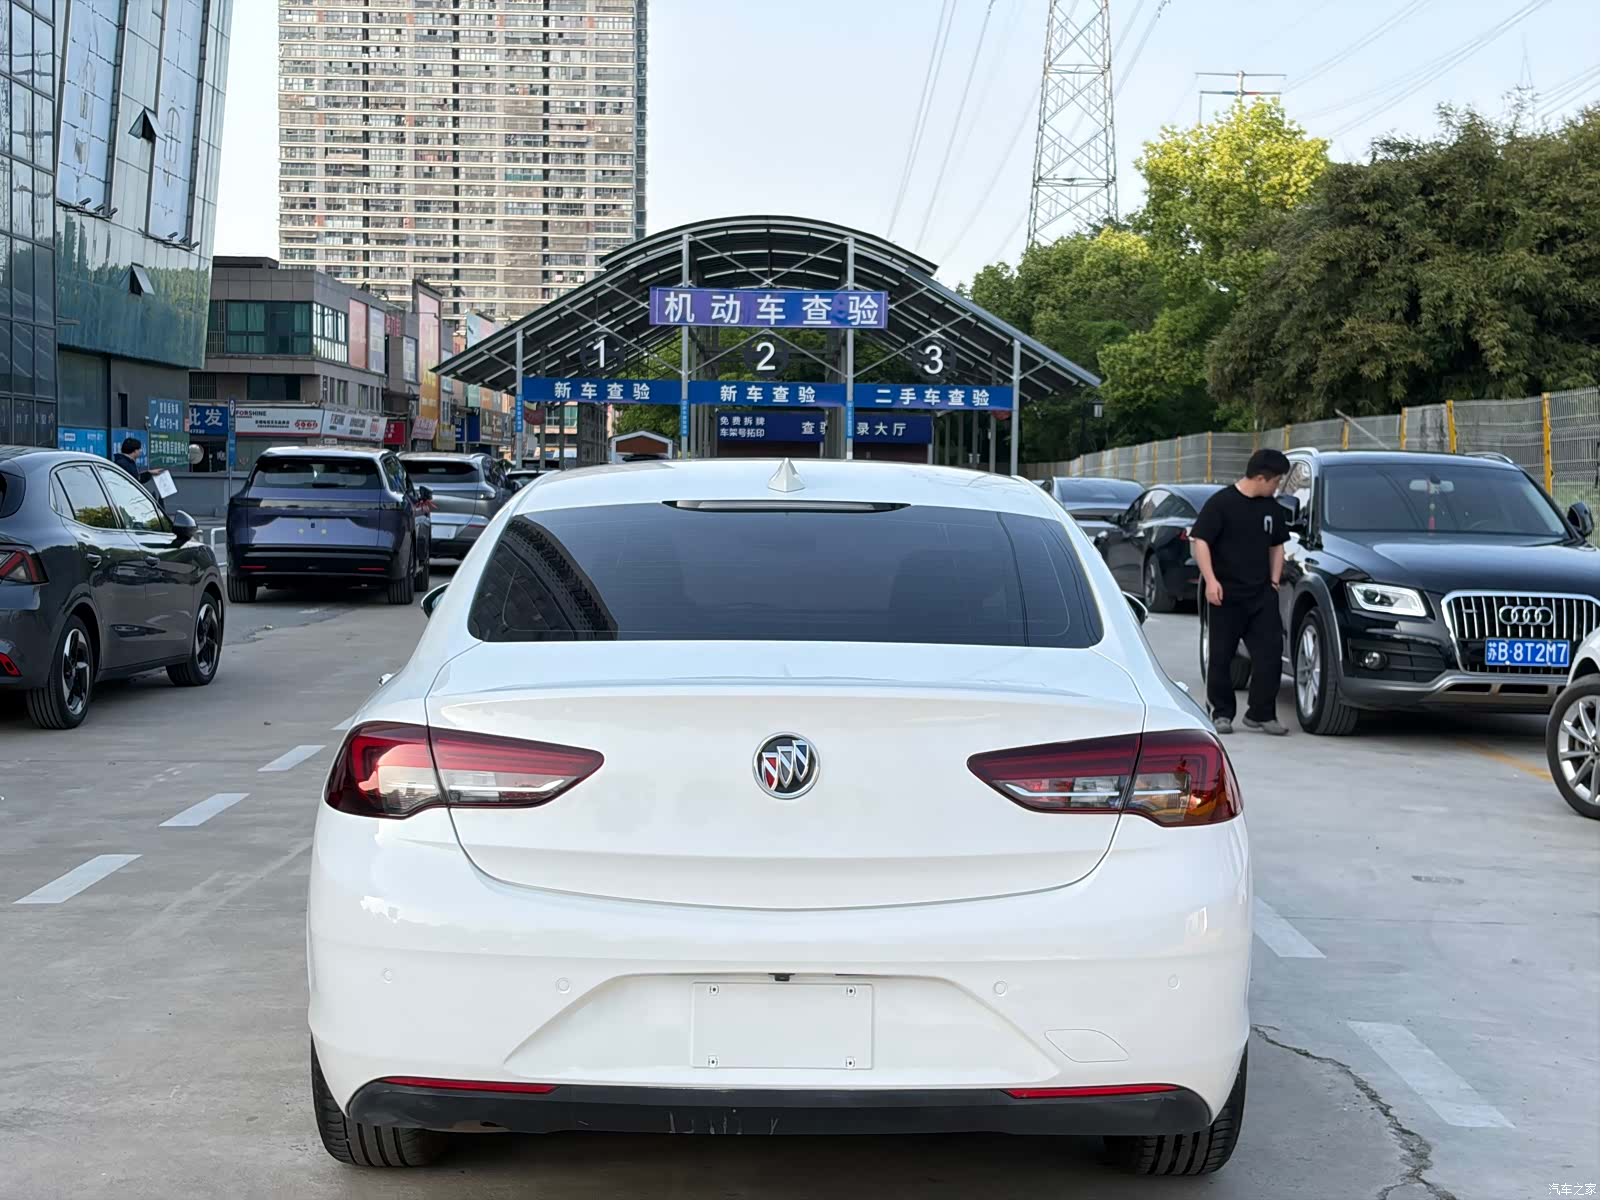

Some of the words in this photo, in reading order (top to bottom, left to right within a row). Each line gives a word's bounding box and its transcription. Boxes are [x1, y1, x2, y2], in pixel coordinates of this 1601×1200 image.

[664, 291, 879, 326] 机动车查验
[593, 339, 605, 368] 1
[756, 342, 776, 371] 2
[923, 345, 944, 374] 3
[554, 381, 651, 401] 新车查验
[720, 384, 816, 403] 新车查验
[875, 388, 990, 407] 二手车查验
[719, 416, 766, 426] 免费拆牌
[801, 421, 907, 436] 查录大厅
[719, 428, 765, 438] 车架号拓印
